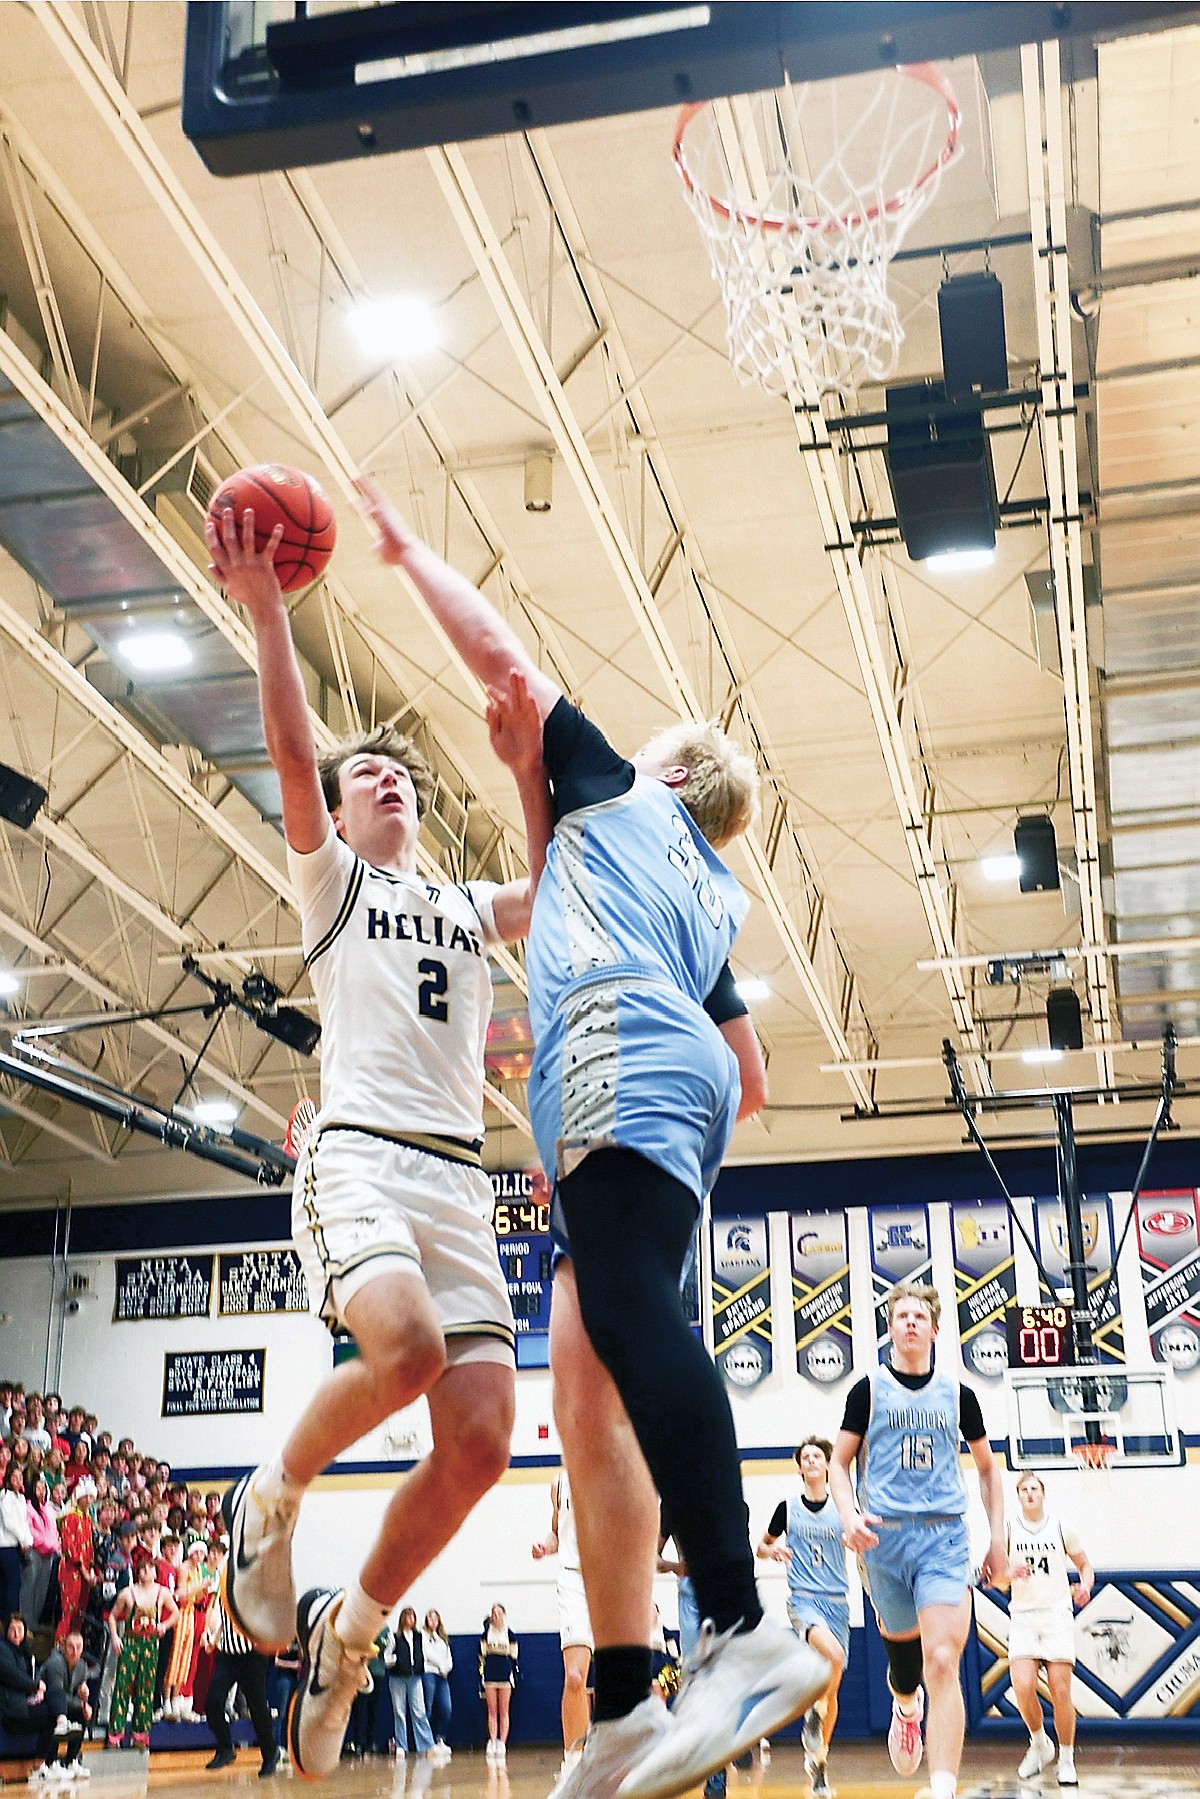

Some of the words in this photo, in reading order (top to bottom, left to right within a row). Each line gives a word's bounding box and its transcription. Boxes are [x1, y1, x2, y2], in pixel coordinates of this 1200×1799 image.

[417, 957, 449, 1023] 2
[495, 1203, 551, 1235] 6:40
[500, 1242, 530, 1256] PERIOD
[1022, 1306, 1067, 1329] 6:40
[1019, 1328, 1060, 1364] 00
[901, 1432, 934, 1471] 15
